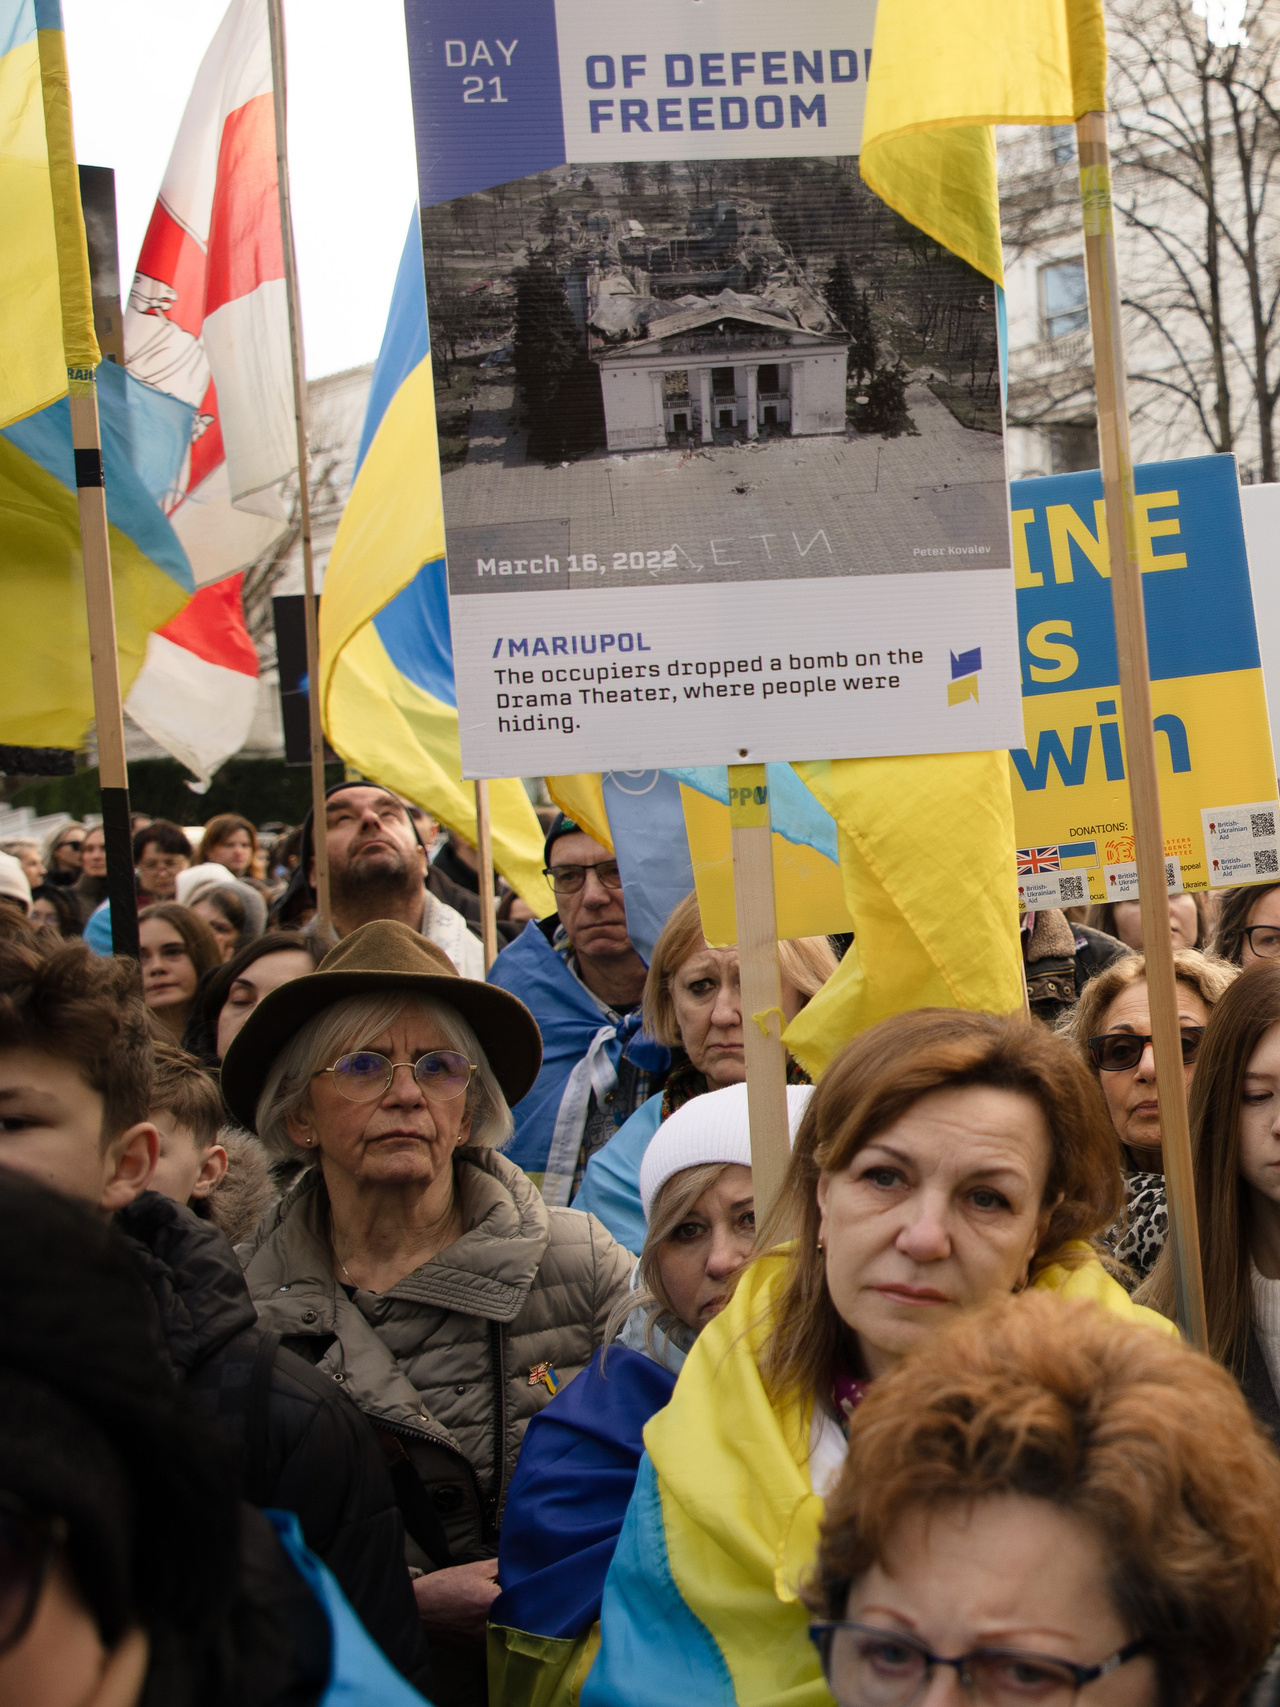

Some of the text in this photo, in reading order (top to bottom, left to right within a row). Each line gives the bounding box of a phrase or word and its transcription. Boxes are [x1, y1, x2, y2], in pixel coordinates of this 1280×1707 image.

[445, 39, 518, 67] DAY
[585, 55, 647, 90] OF
[462, 76, 508, 103] 21
[589, 94, 827, 133] FREEDOM
[477, 550, 678, 577] March 16, 2022
[913, 545, 991, 557] Peter Kovalev
[492, 632, 651, 658] /MARIUPOL
[494, 648, 923, 685] The occupiers dropped a bomb on the
[497, 675, 900, 709] Drama Theater, where people were
[498, 714, 580, 734] hiding.
[1009, 699, 1191, 791] win
[1069, 822, 1128, 837] DONATIONS:
[1163, 837, 1191, 845] STERS
[1218, 826, 1248, 834] Ukrainian
[1221, 863, 1251, 871] Ukrainian
[1027, 890, 1056, 898] Ukrainian
